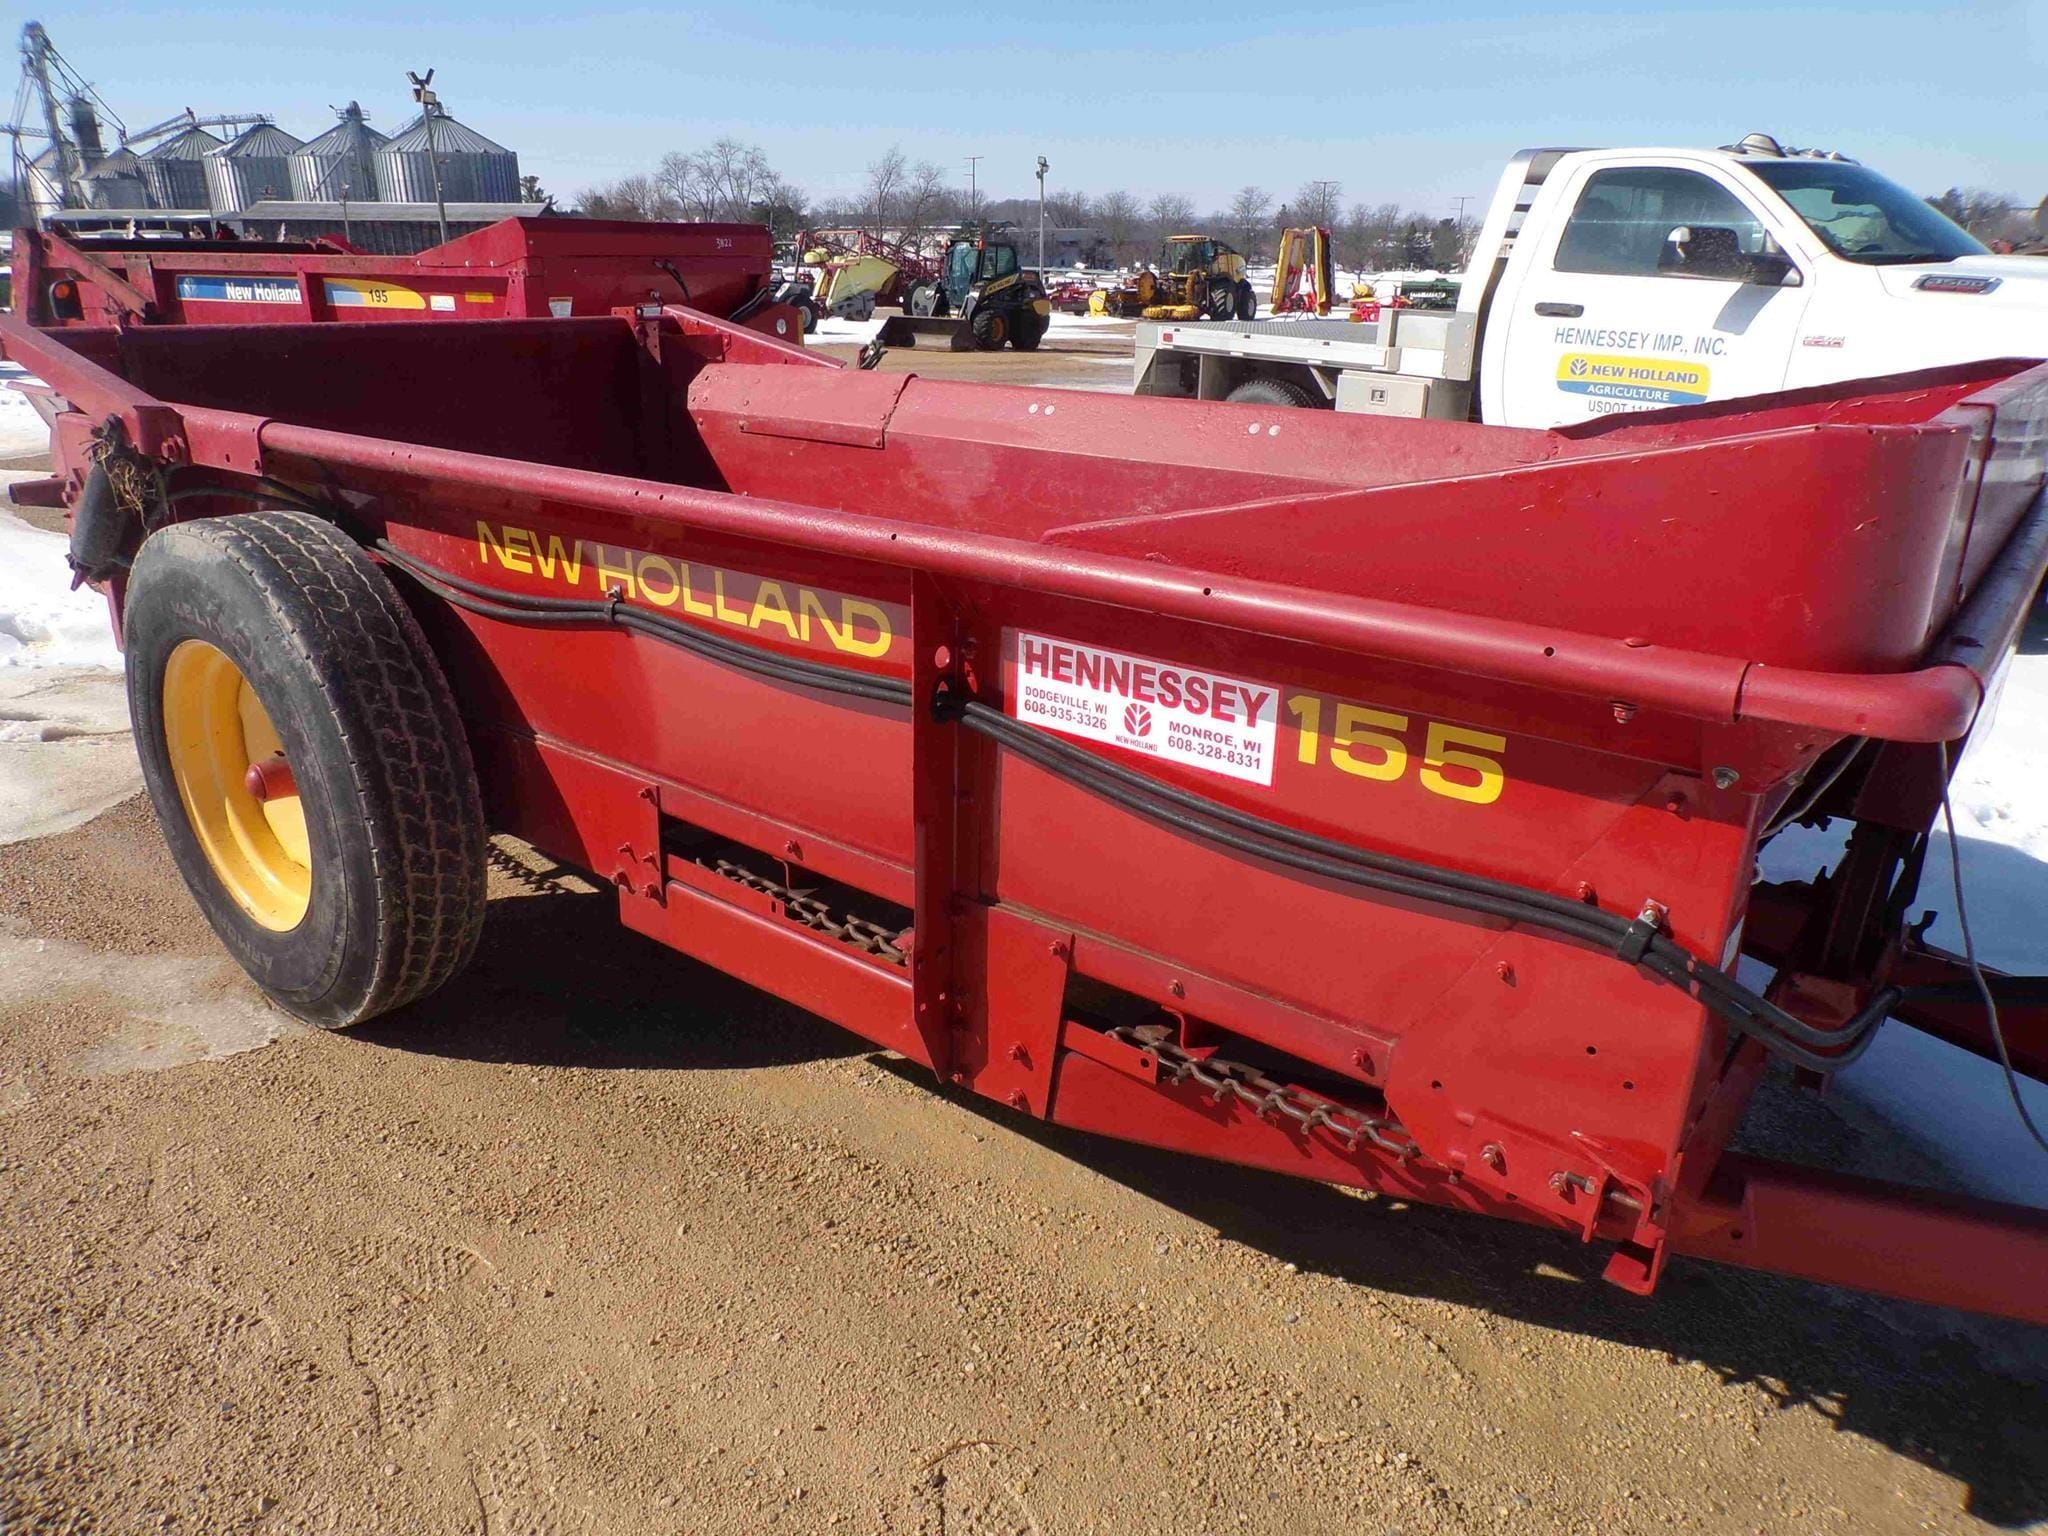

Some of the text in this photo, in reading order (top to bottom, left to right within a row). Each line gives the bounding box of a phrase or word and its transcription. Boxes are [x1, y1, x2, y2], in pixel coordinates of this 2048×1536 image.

[226, 283, 300, 303] New Holland
[368, 289, 388, 303] 195
[1555, 327, 1728, 356] HENNESSEY IMP., INC.
[1591, 365, 1699, 384] NEW HOLLAND
[1587, 385, 1670, 400] AGRICULTURE
[1588, 399, 1627, 413] USDOT
[476, 521, 892, 658] NEW HOLLAND
[1024, 639, 1270, 728] HENNESSEY
[1024, 699, 1107, 730] 608-935-3326
[1025, 686, 1108, 716] DODGEVILLE, WI
[1115, 735, 1158, 752] NEW HOLLAND
[1169, 721, 1262, 754] MONROE, WI
[1287, 694, 1507, 805] 155
[1168, 735, 1261, 770] 608-328-8331
